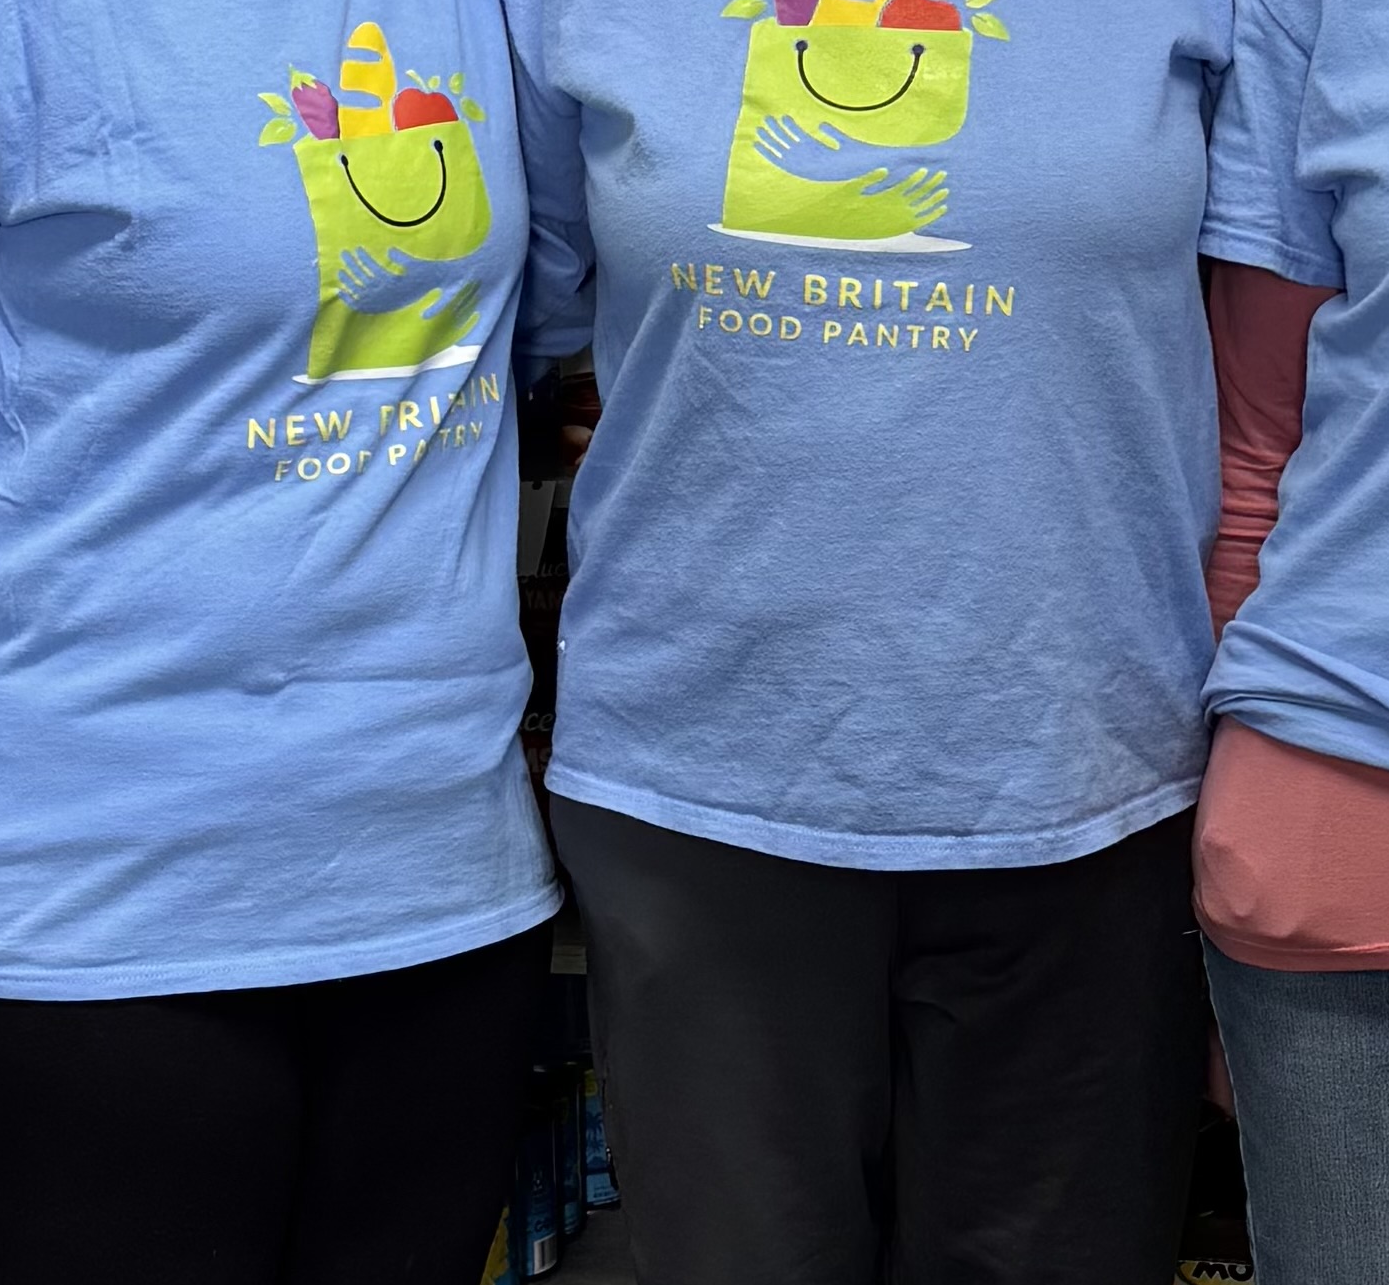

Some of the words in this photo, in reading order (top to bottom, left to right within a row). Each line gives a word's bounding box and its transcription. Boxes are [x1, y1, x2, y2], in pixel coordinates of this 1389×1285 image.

[670, 263, 776, 299] NEW
[804, 273, 1015, 317] BRITAIN
[698, 306, 802, 340] FOOD
[823, 320, 978, 352] PANTRY
[247, 410, 353, 449] NEW
